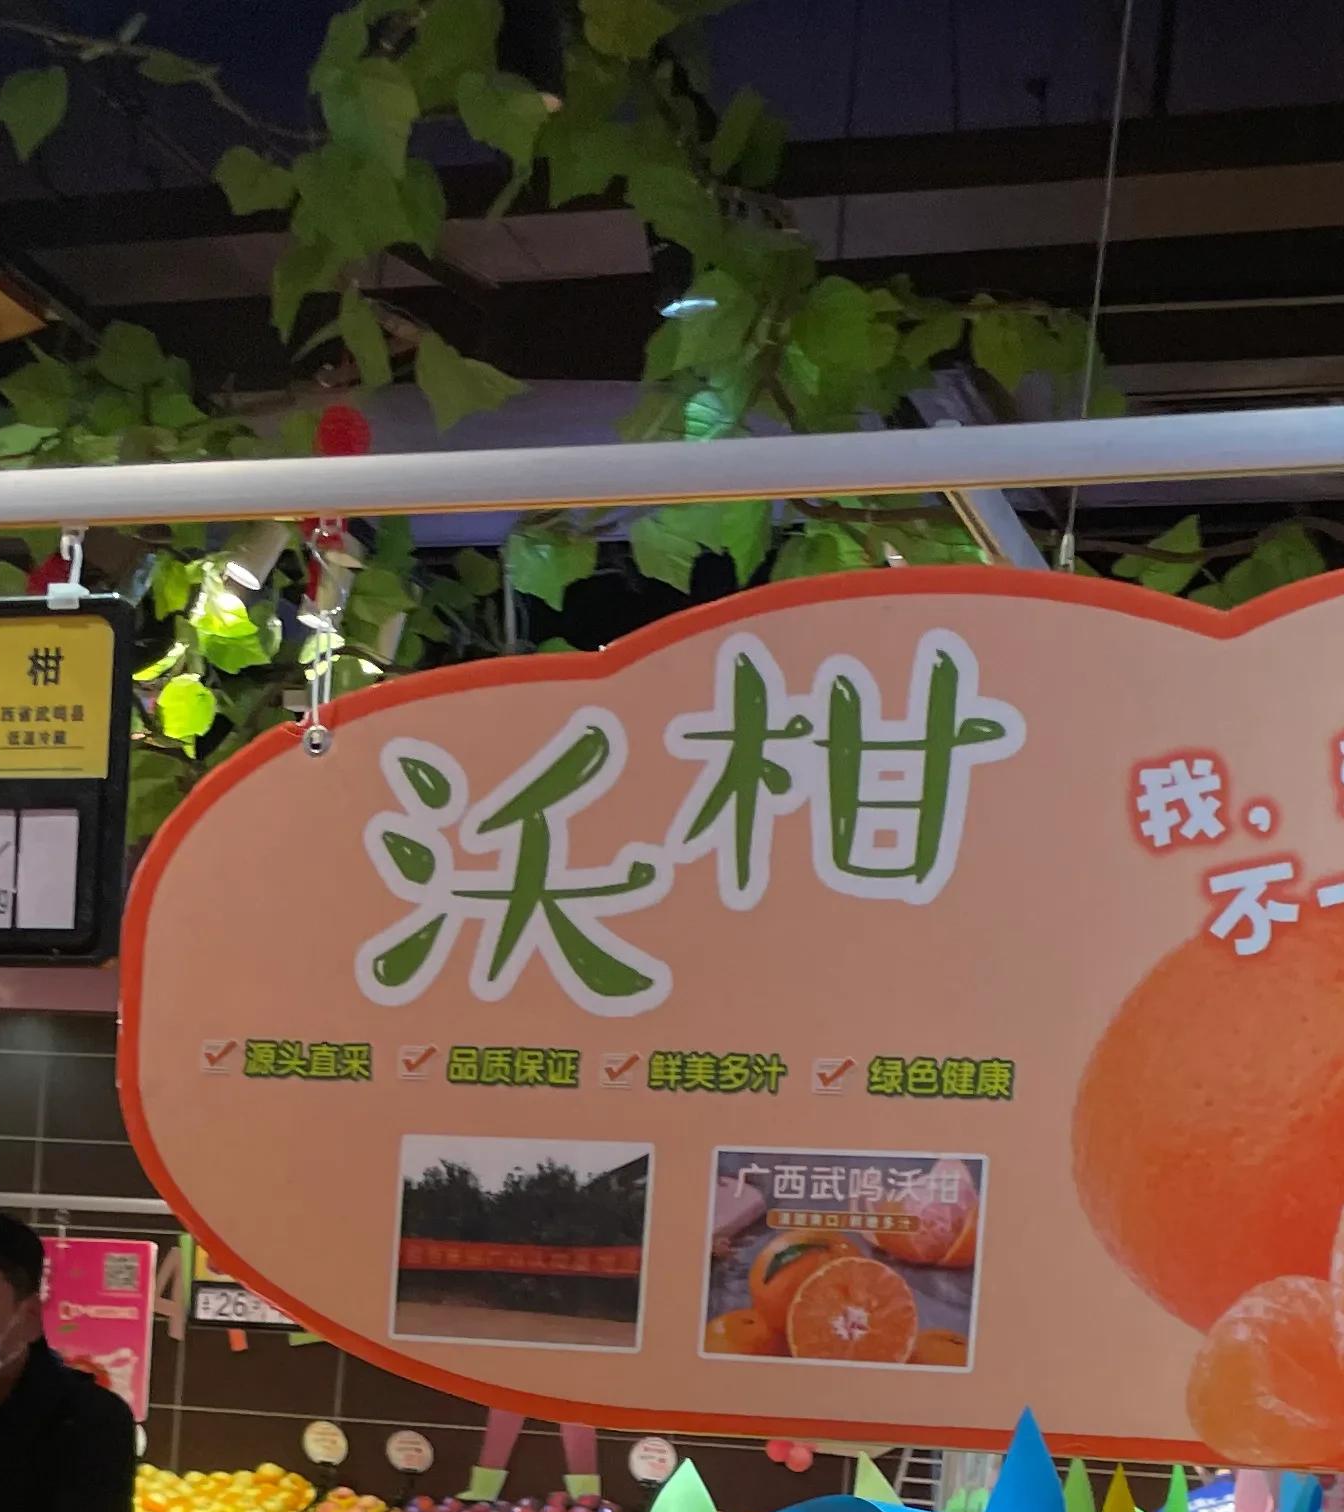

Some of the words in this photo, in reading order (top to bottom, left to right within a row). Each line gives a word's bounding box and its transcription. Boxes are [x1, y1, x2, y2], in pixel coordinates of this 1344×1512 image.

[366, 642, 1014, 1002] 沃柑
[244, 1040, 373, 1082] 源头直采
[446, 1046, 581, 1088] 品质保证
[647, 1050, 787, 1095] 鲜美多汁
[867, 1056, 1016, 1100] 绿色健康
[733, 1161, 963, 1205] 广西武鸣沃柑
